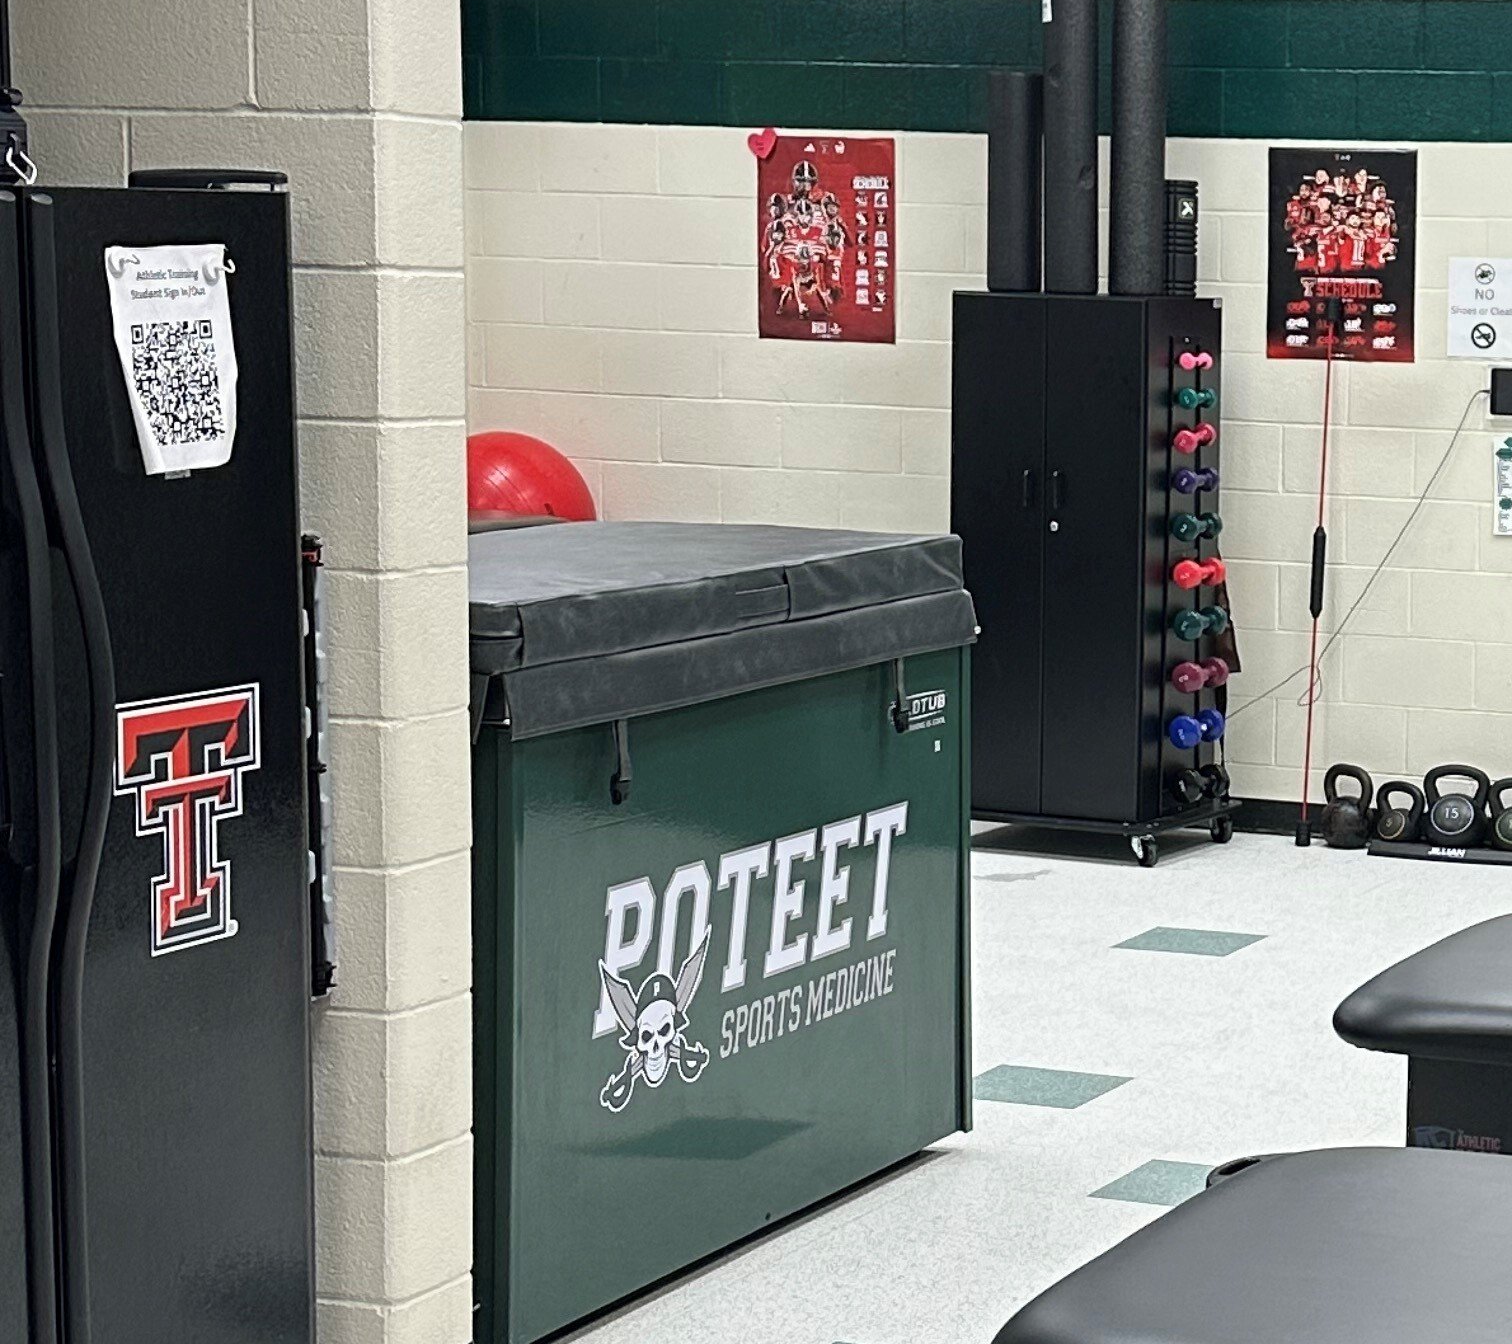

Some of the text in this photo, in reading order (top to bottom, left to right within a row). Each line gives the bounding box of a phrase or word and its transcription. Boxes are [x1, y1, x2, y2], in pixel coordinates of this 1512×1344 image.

[1474, 288, 1495, 301] NO
[1444, 807, 1459, 819] 15
[592, 800, 909, 1041] POTEET
[719, 948, 898, 1059] SPORTS MEDICINE
[1456, 1133, 1501, 1151] ATHLETIC
